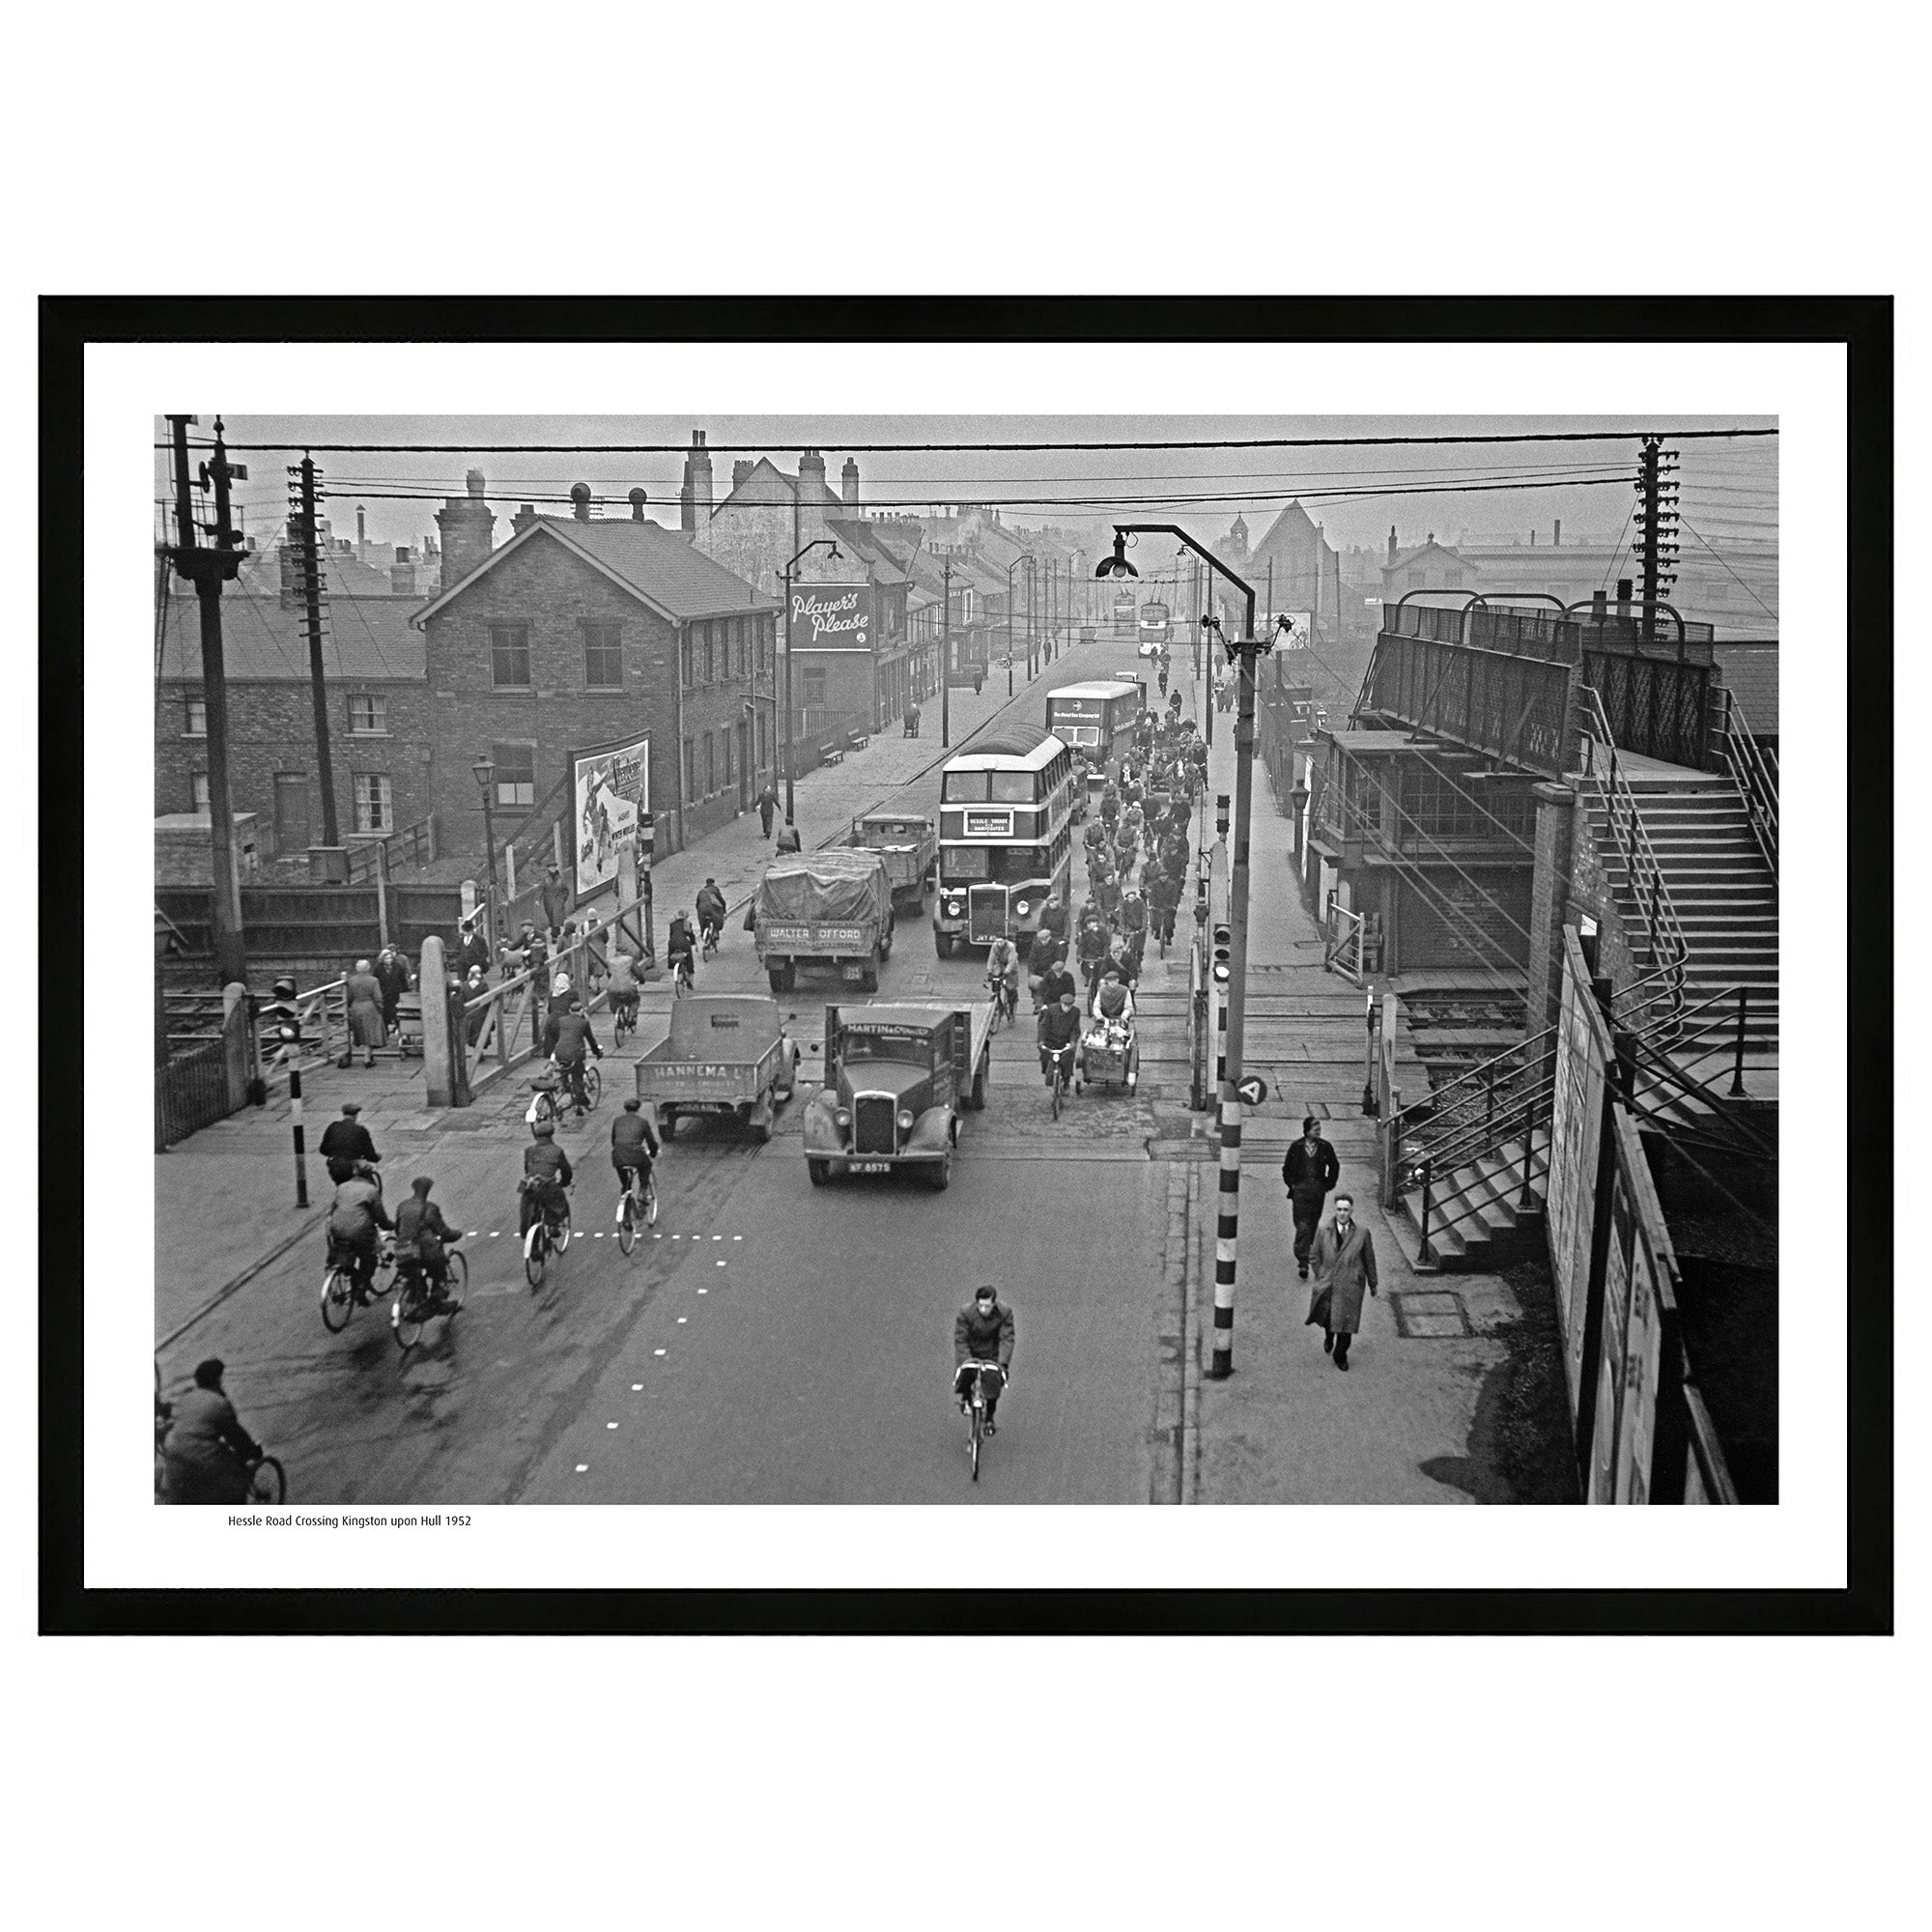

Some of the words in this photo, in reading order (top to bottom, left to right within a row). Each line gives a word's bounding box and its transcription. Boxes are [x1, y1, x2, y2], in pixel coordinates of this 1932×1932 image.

[792, 593, 859, 623] Player's
[811, 613, 868, 641] Please
[770, 928, 810, 938] WALTER
[818, 928, 861, 939] OFFORD
[655, 1065, 726, 1077] HANNEMA
